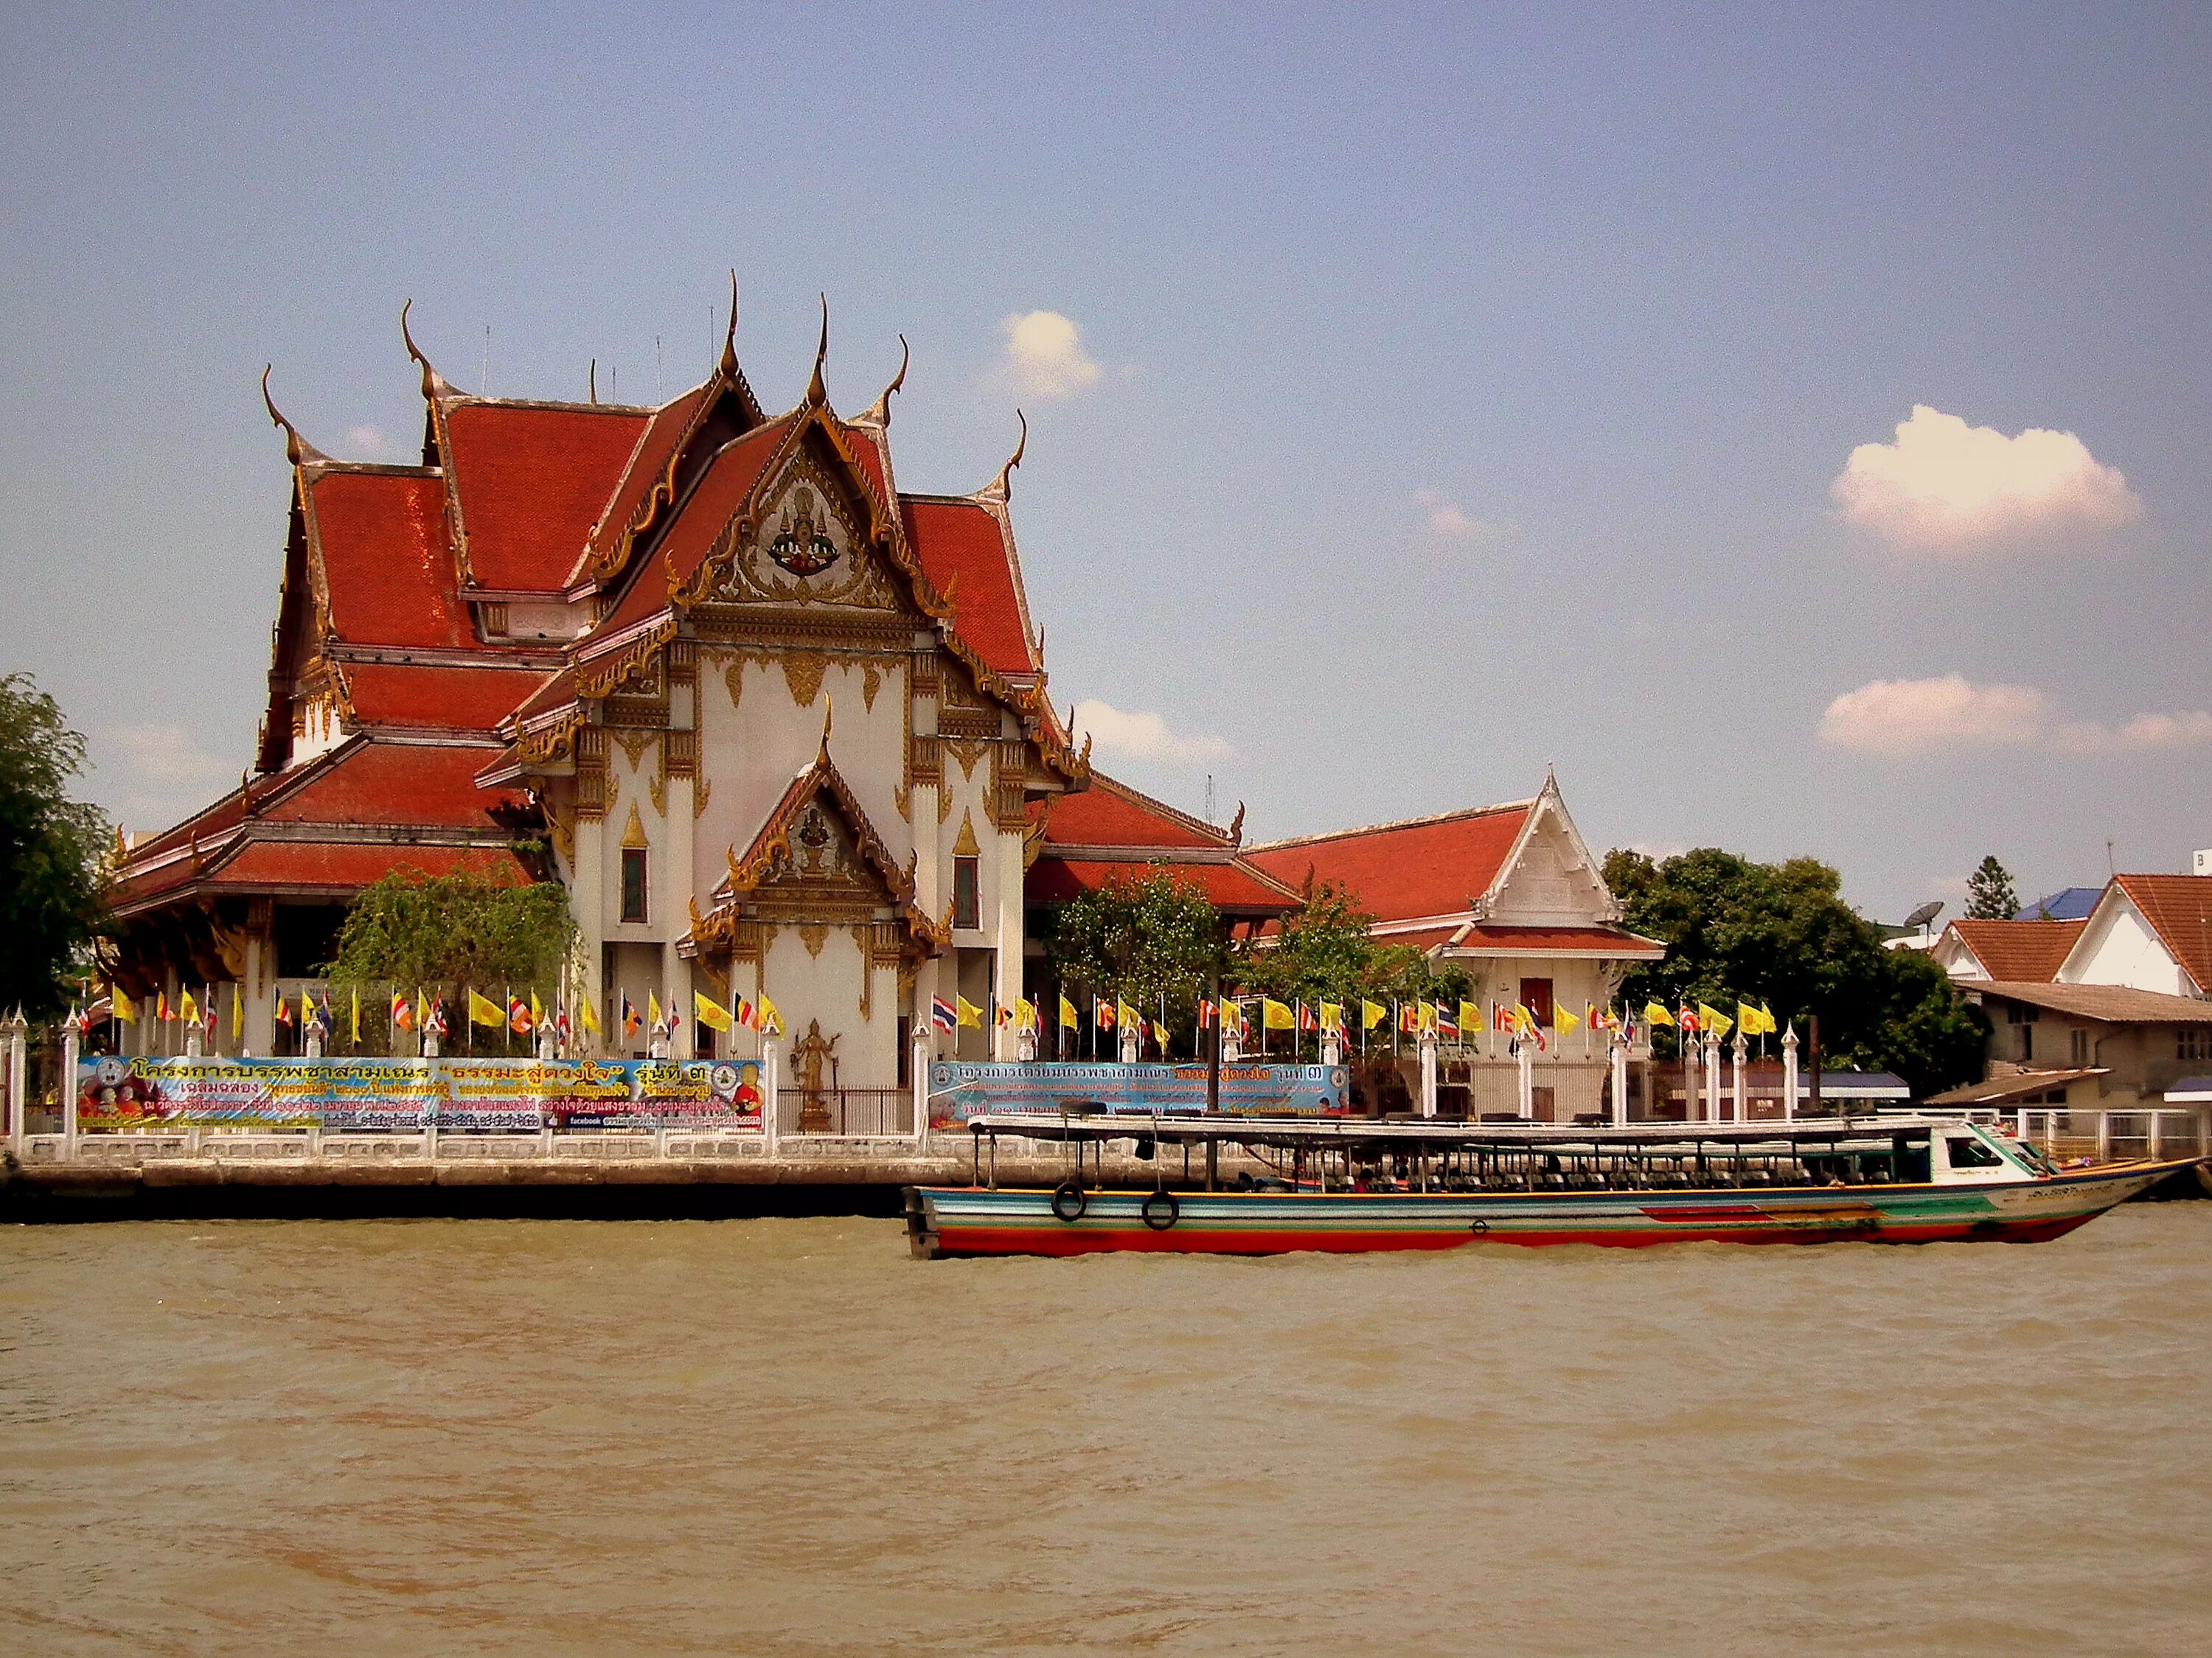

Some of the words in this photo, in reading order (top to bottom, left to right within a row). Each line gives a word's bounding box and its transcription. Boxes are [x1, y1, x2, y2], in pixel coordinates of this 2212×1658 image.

[131, 1059, 429, 1078] โครงการบรรพชาสามเณร
[635, 1061, 681, 1085] รุ่นที่
[690, 1067, 706, 1079] ๓
[1308, 1066, 1321, 1079] ๓
[181, 1079, 258, 1093] เฉลิมฉลอง
[570, 1116, 601, 1125] facebook
